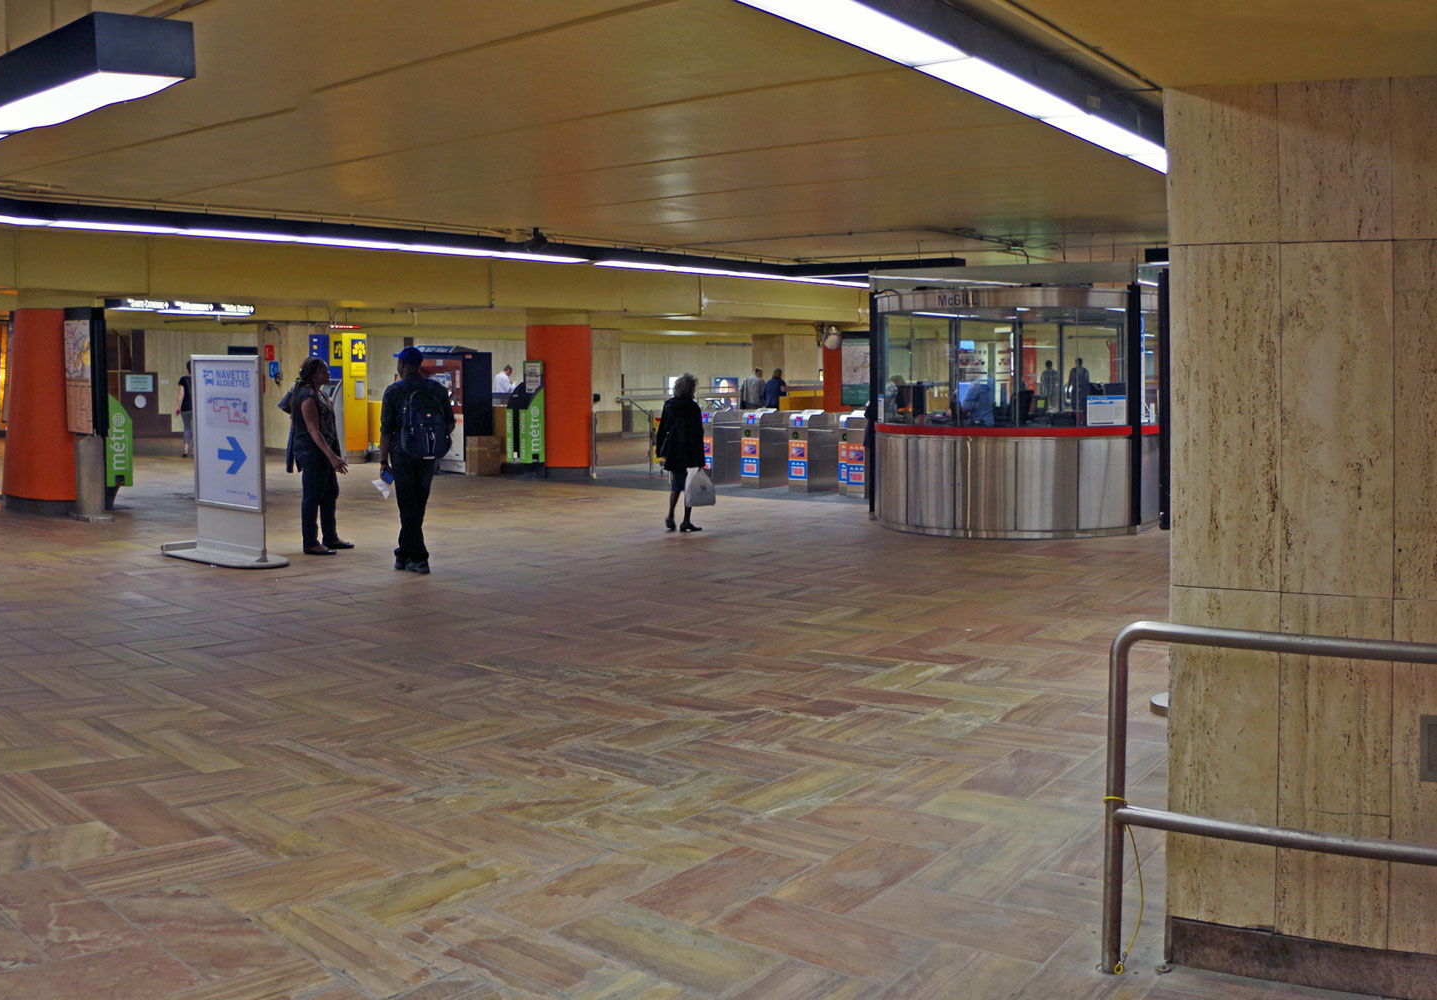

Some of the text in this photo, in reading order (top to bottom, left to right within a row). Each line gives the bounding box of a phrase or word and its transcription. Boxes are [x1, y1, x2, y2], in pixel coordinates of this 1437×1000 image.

[215, 370, 250, 380] NAVETTE
[215, 379, 251, 388] ALOUETTES
[110, 412, 126, 471] métro
[530, 406, 540, 452] métro
